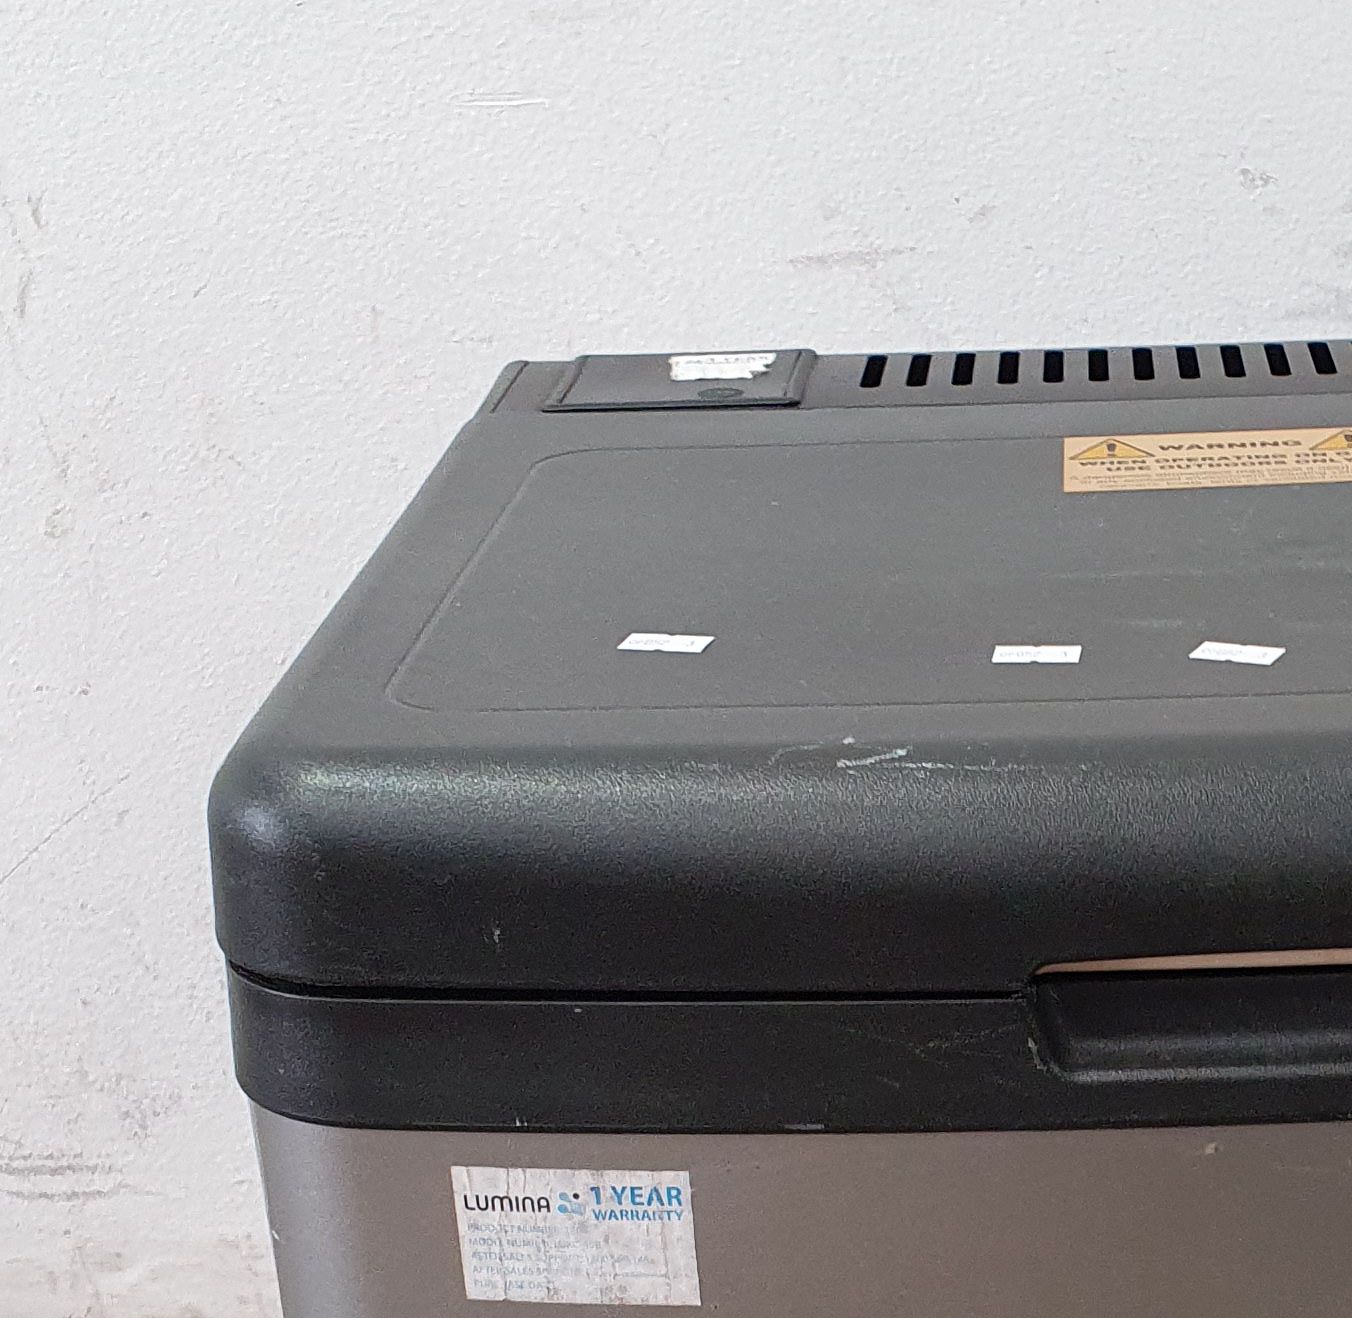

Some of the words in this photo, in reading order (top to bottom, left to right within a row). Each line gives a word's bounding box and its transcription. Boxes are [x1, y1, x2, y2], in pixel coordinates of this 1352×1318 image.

[1158, 439, 1303, 451] WARNING
[1079, 458, 1147, 467] WHEN
[1154, 453, 1288, 464] OPERATING
[1159, 459, 1287, 471] OUTDOORS
[463, 1194, 551, 1213] LUMINA
[590, 1186, 602, 1206] 1
[611, 1186, 683, 1206] YEAR
[592, 1209, 684, 1222] WARRANTY
